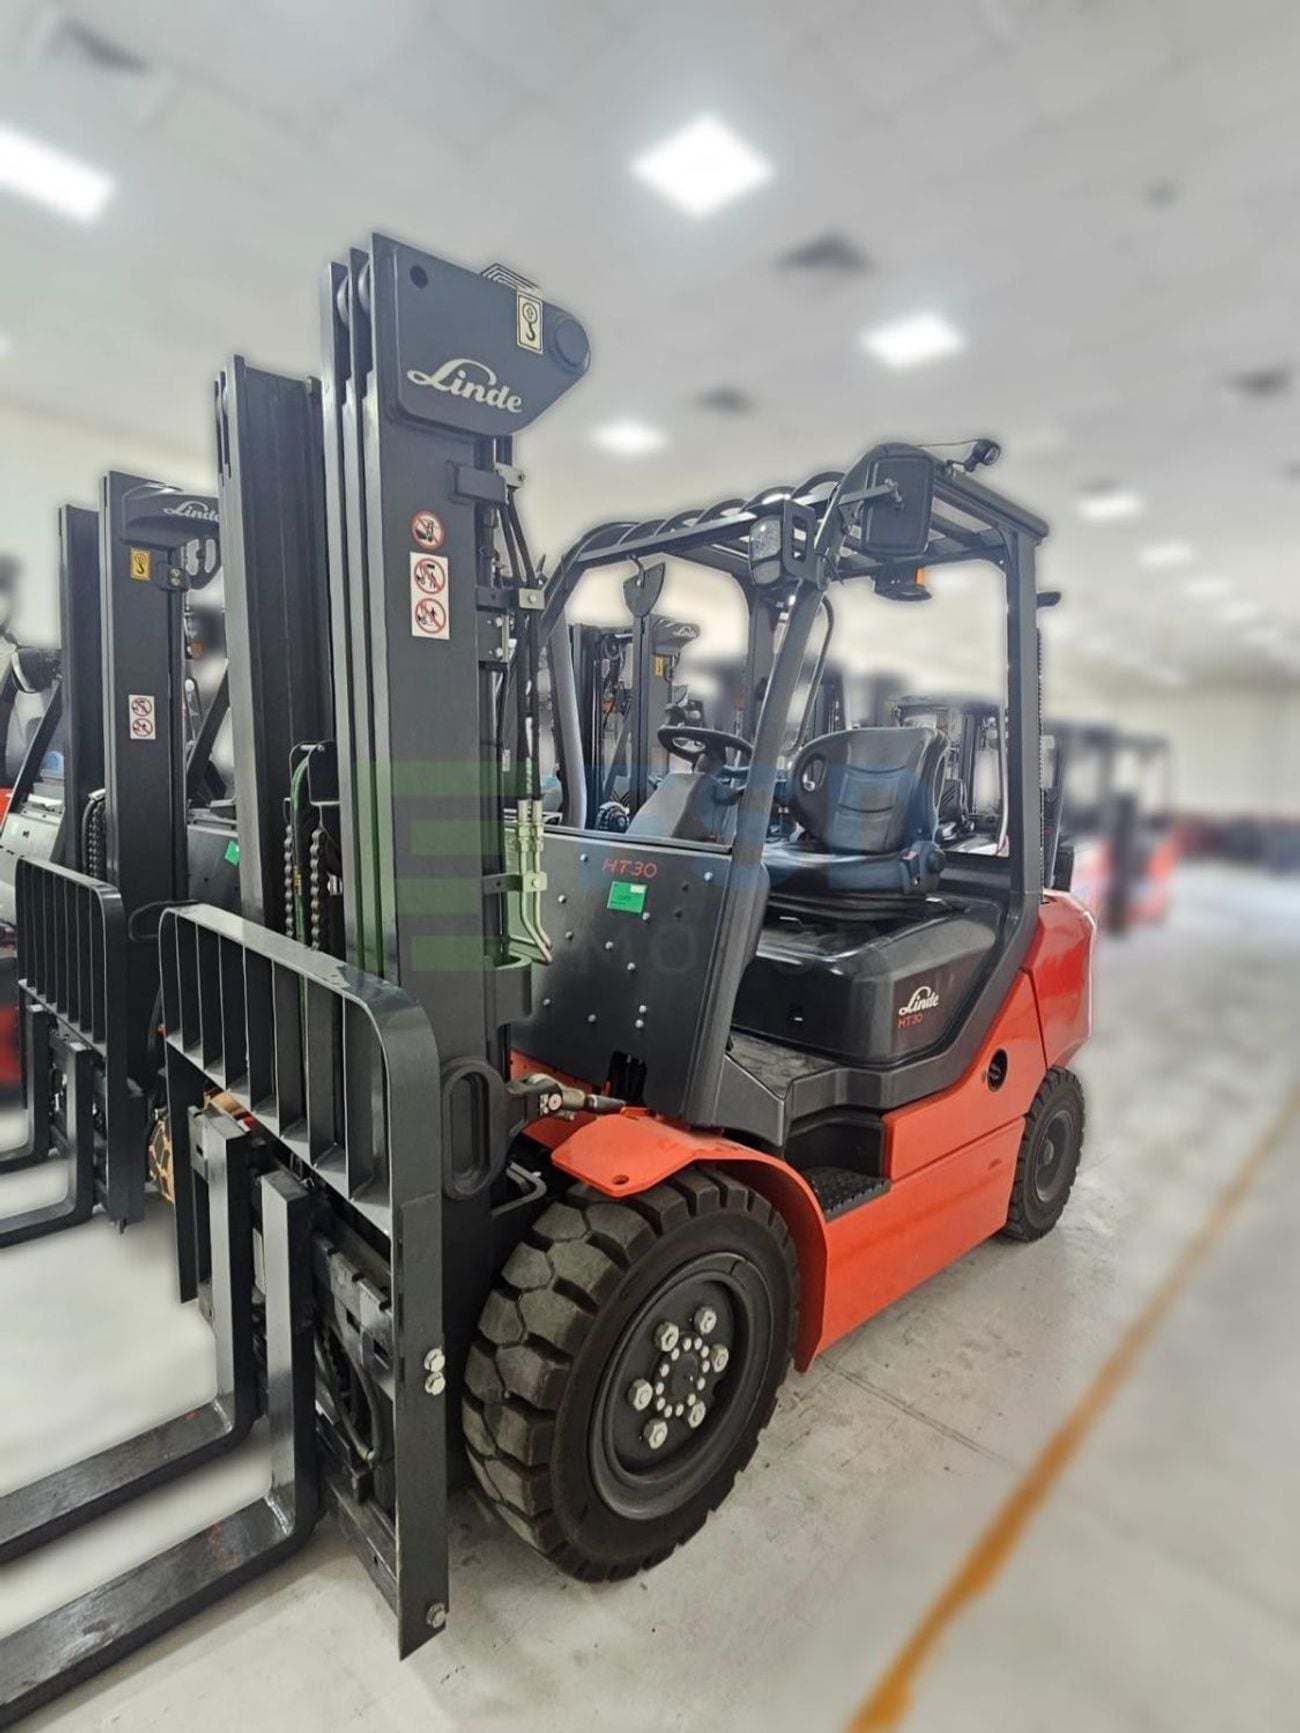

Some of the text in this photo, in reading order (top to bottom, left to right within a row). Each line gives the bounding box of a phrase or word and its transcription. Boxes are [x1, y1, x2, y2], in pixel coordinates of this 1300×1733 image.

[407, 358, 523, 413] Linde
[601, 857, 658, 878] HT30
[898, 985, 940, 1016] Linde
